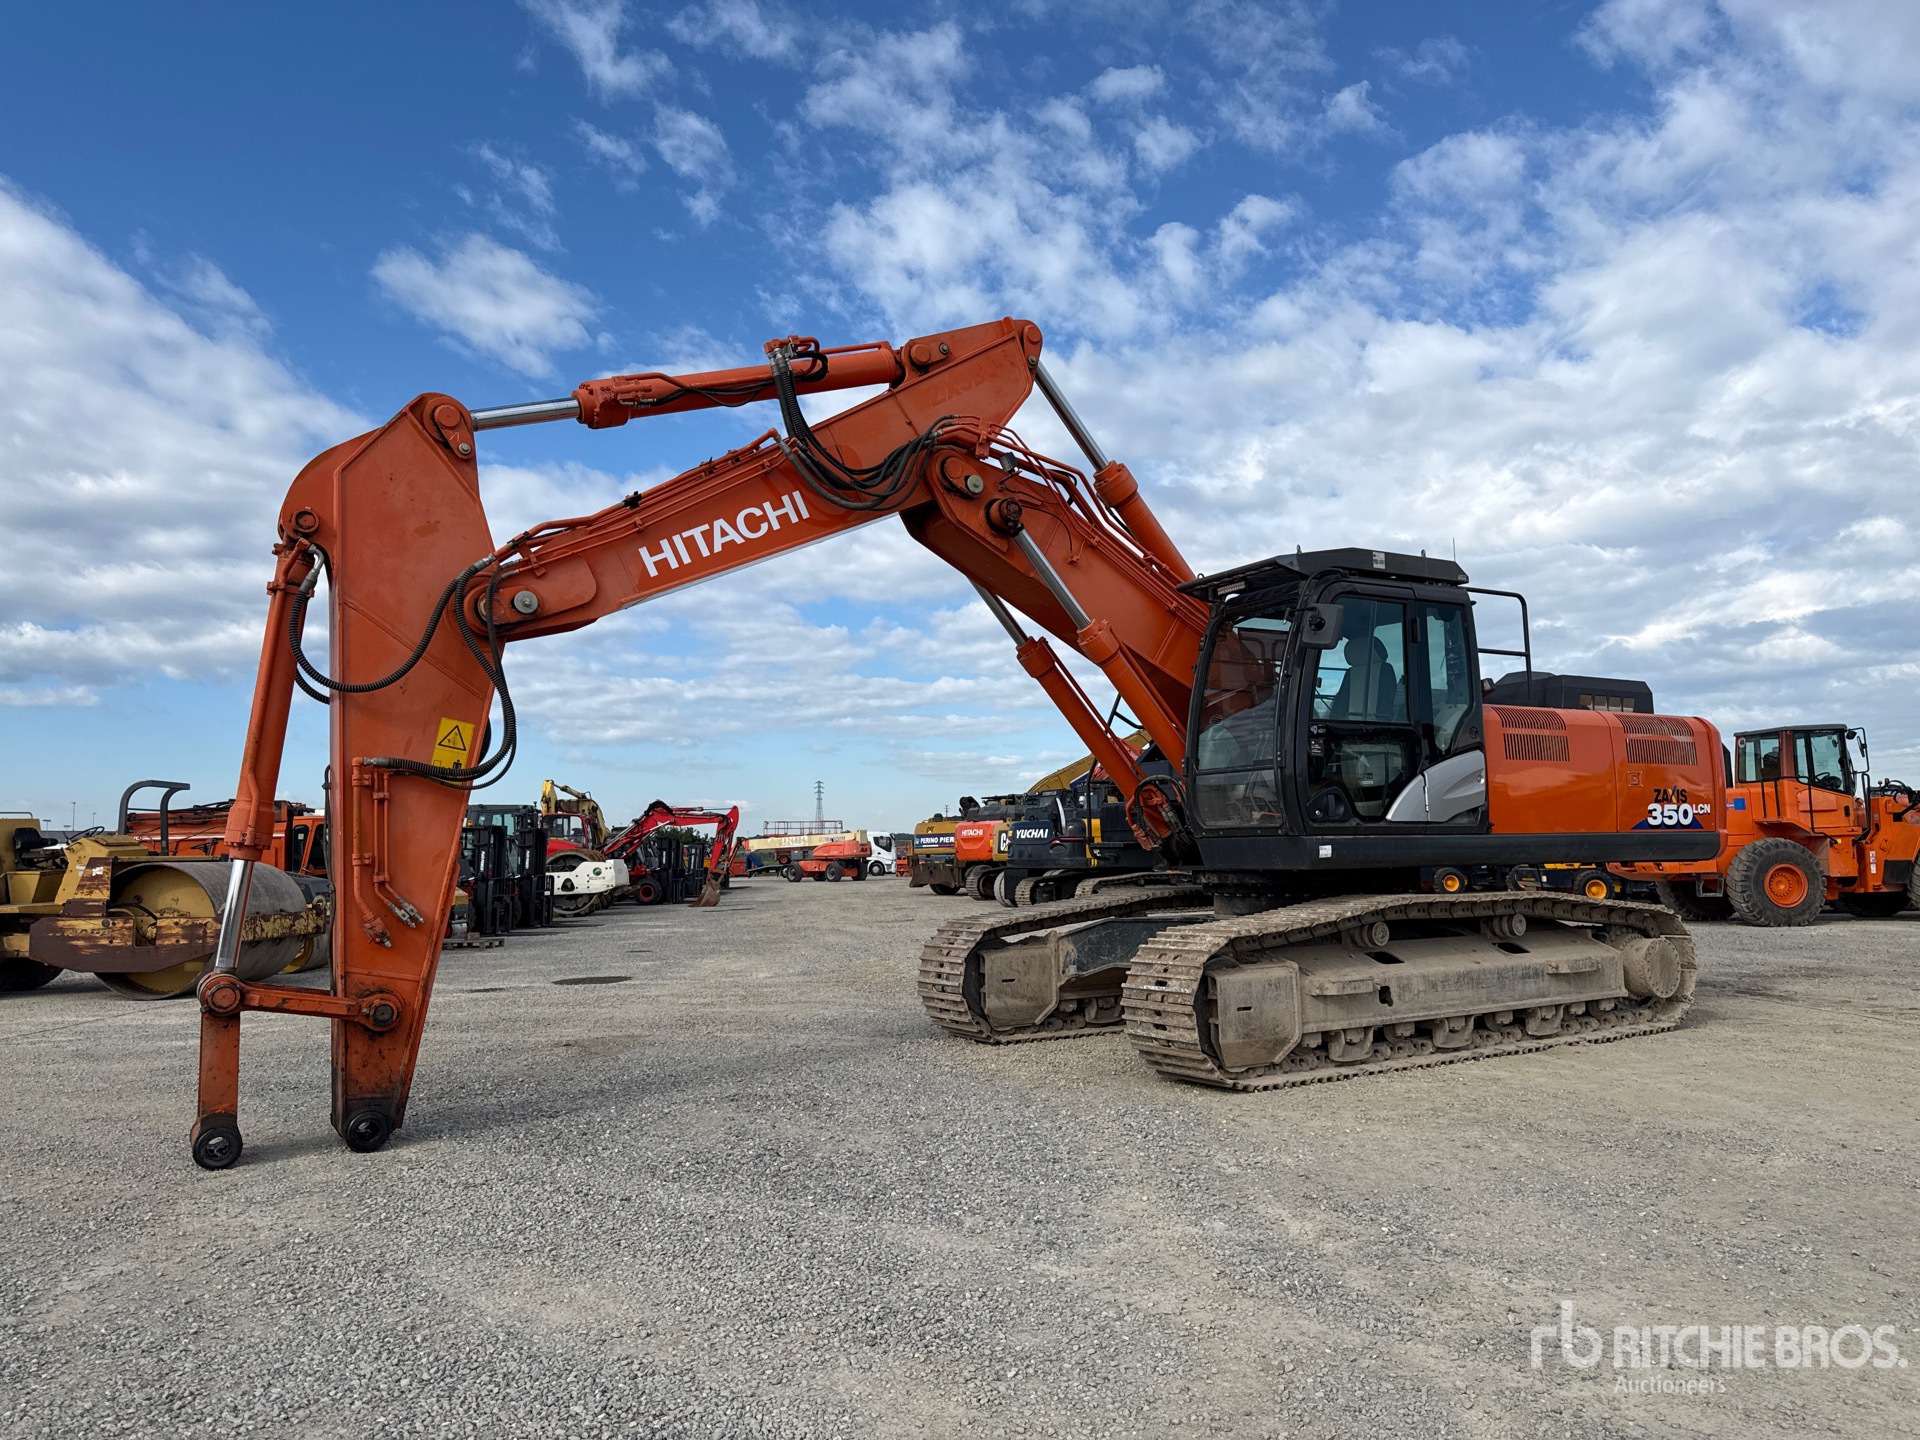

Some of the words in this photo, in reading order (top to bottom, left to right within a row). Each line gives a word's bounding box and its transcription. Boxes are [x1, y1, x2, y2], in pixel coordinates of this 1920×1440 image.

[638, 490, 811, 578] HITACHI
[1654, 786, 1687, 803] ZAXIS
[1647, 803, 1693, 827] 350
[1693, 804, 1711, 814] LCN
[961, 829, 984, 837] HITACHI
[1016, 828, 1049, 838] YUCHAI
[920, 836, 939, 844] PERINO
